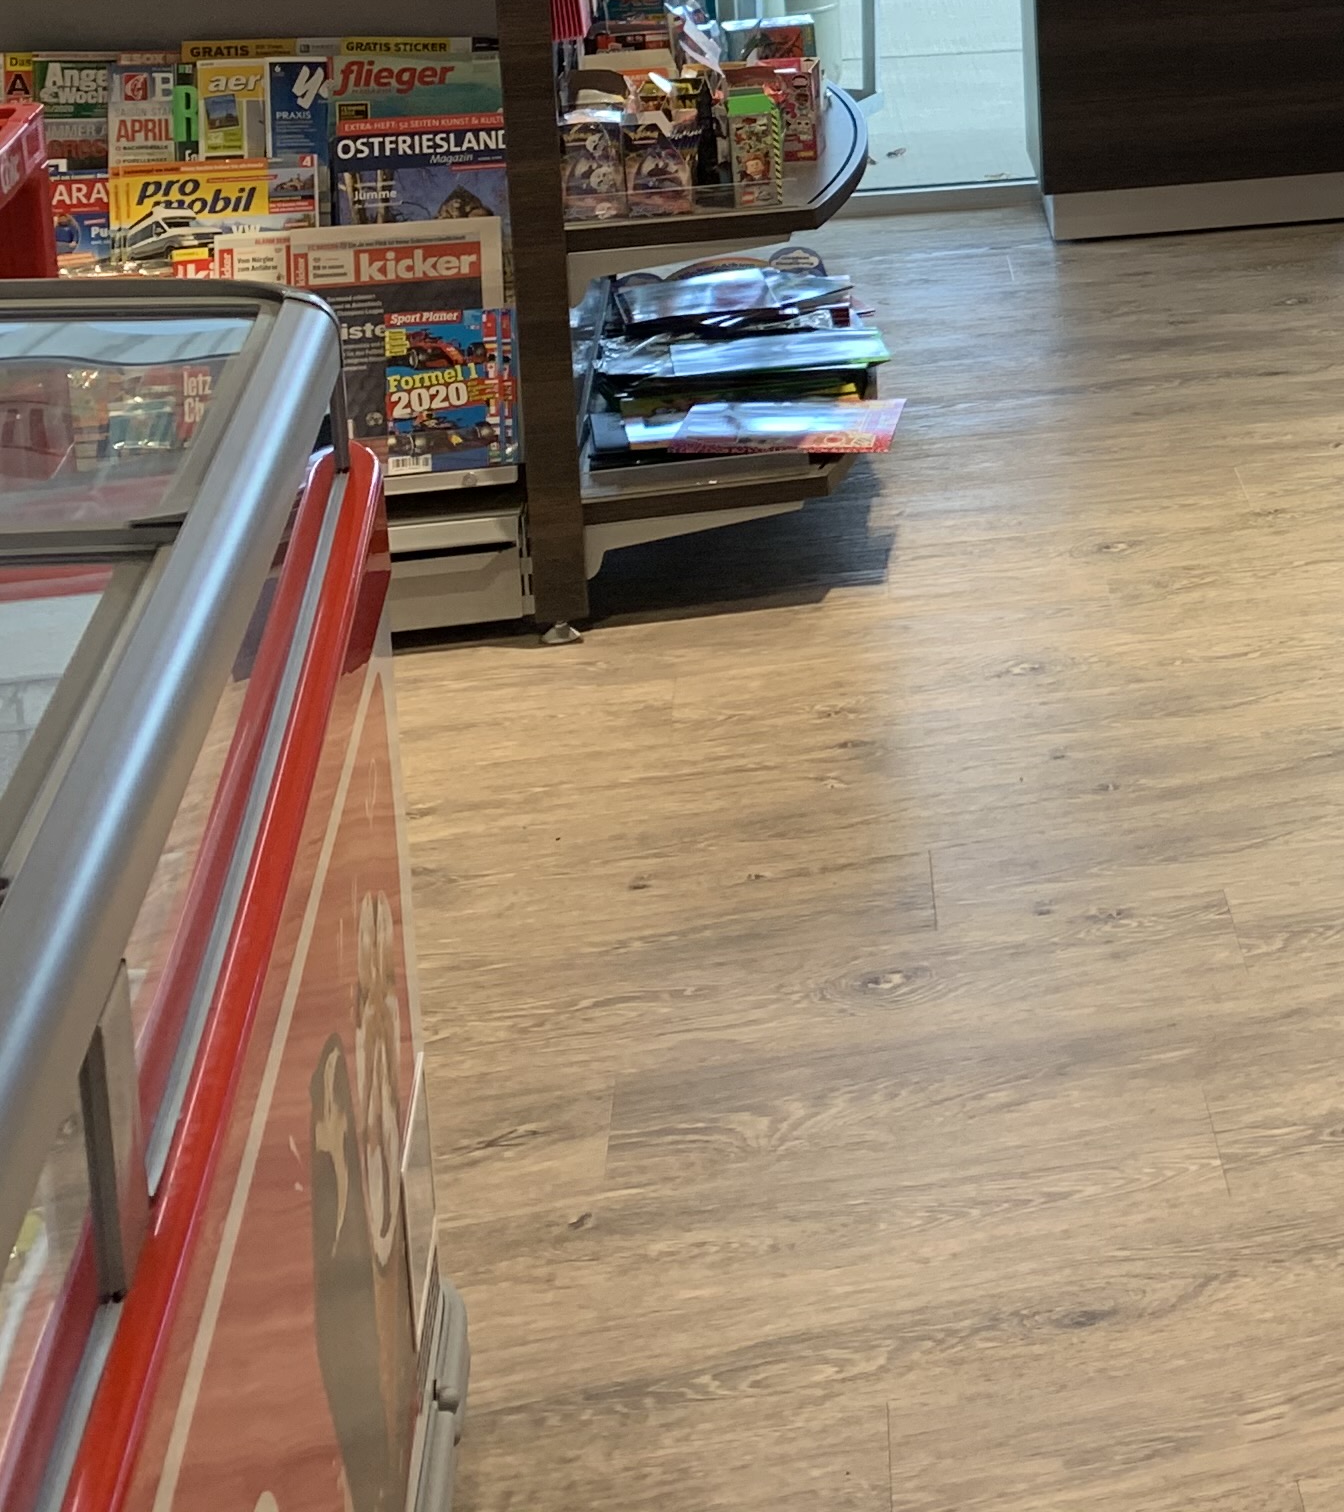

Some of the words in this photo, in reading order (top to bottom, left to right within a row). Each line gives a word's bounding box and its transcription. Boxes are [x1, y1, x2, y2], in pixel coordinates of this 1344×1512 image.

[190, 45, 249, 57] GRATIS
[346, 42, 390, 52] GRATIS
[394, 42, 447, 53] STICKER
[333, 59, 455, 97] flieger
[276, 110, 311, 120] PRAXIS
[411, 119, 438, 129] SEITEN
[440, 117, 469, 127] KUNST
[116, 119, 173, 143] APRIL
[302, 157, 312, 167] 4
[430, 153, 474, 166] Magazin
[136, 179, 200, 206] pro
[354, 188, 397, 201] Jümme
[359, 249, 478, 282] kicker
[390, 312, 419, 326] Sport
[421, 311, 458, 324] Planer
[388, 364, 465, 393] Formel
[467, 363, 479, 379] 1
[390, 382, 469, 419] 2020
